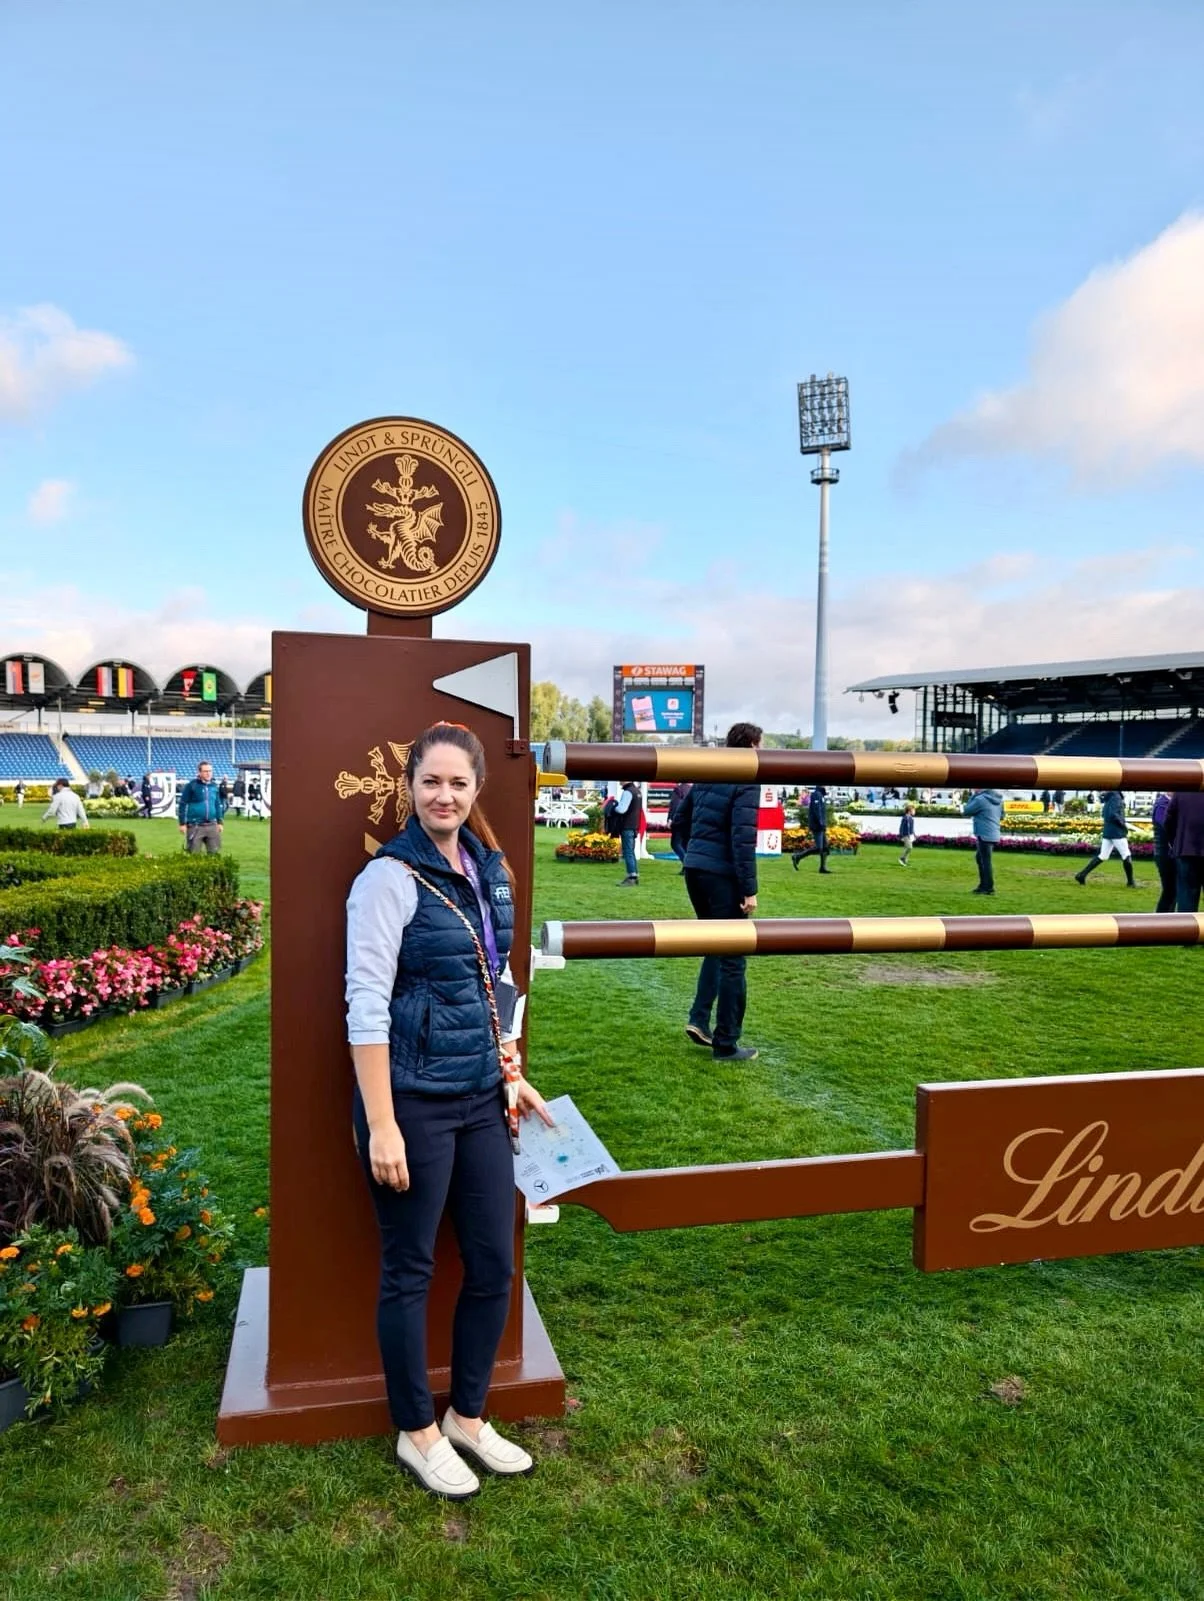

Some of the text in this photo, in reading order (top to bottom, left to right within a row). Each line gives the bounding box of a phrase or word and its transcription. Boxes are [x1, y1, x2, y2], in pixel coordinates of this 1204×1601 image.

[333, 430, 478, 487] LINDT & SPRÜNGLI
[317, 484, 489, 602] MAÎTRE CHOCOLATIER DEPUIS 1845
[643, 666, 687, 676] STAWAG
